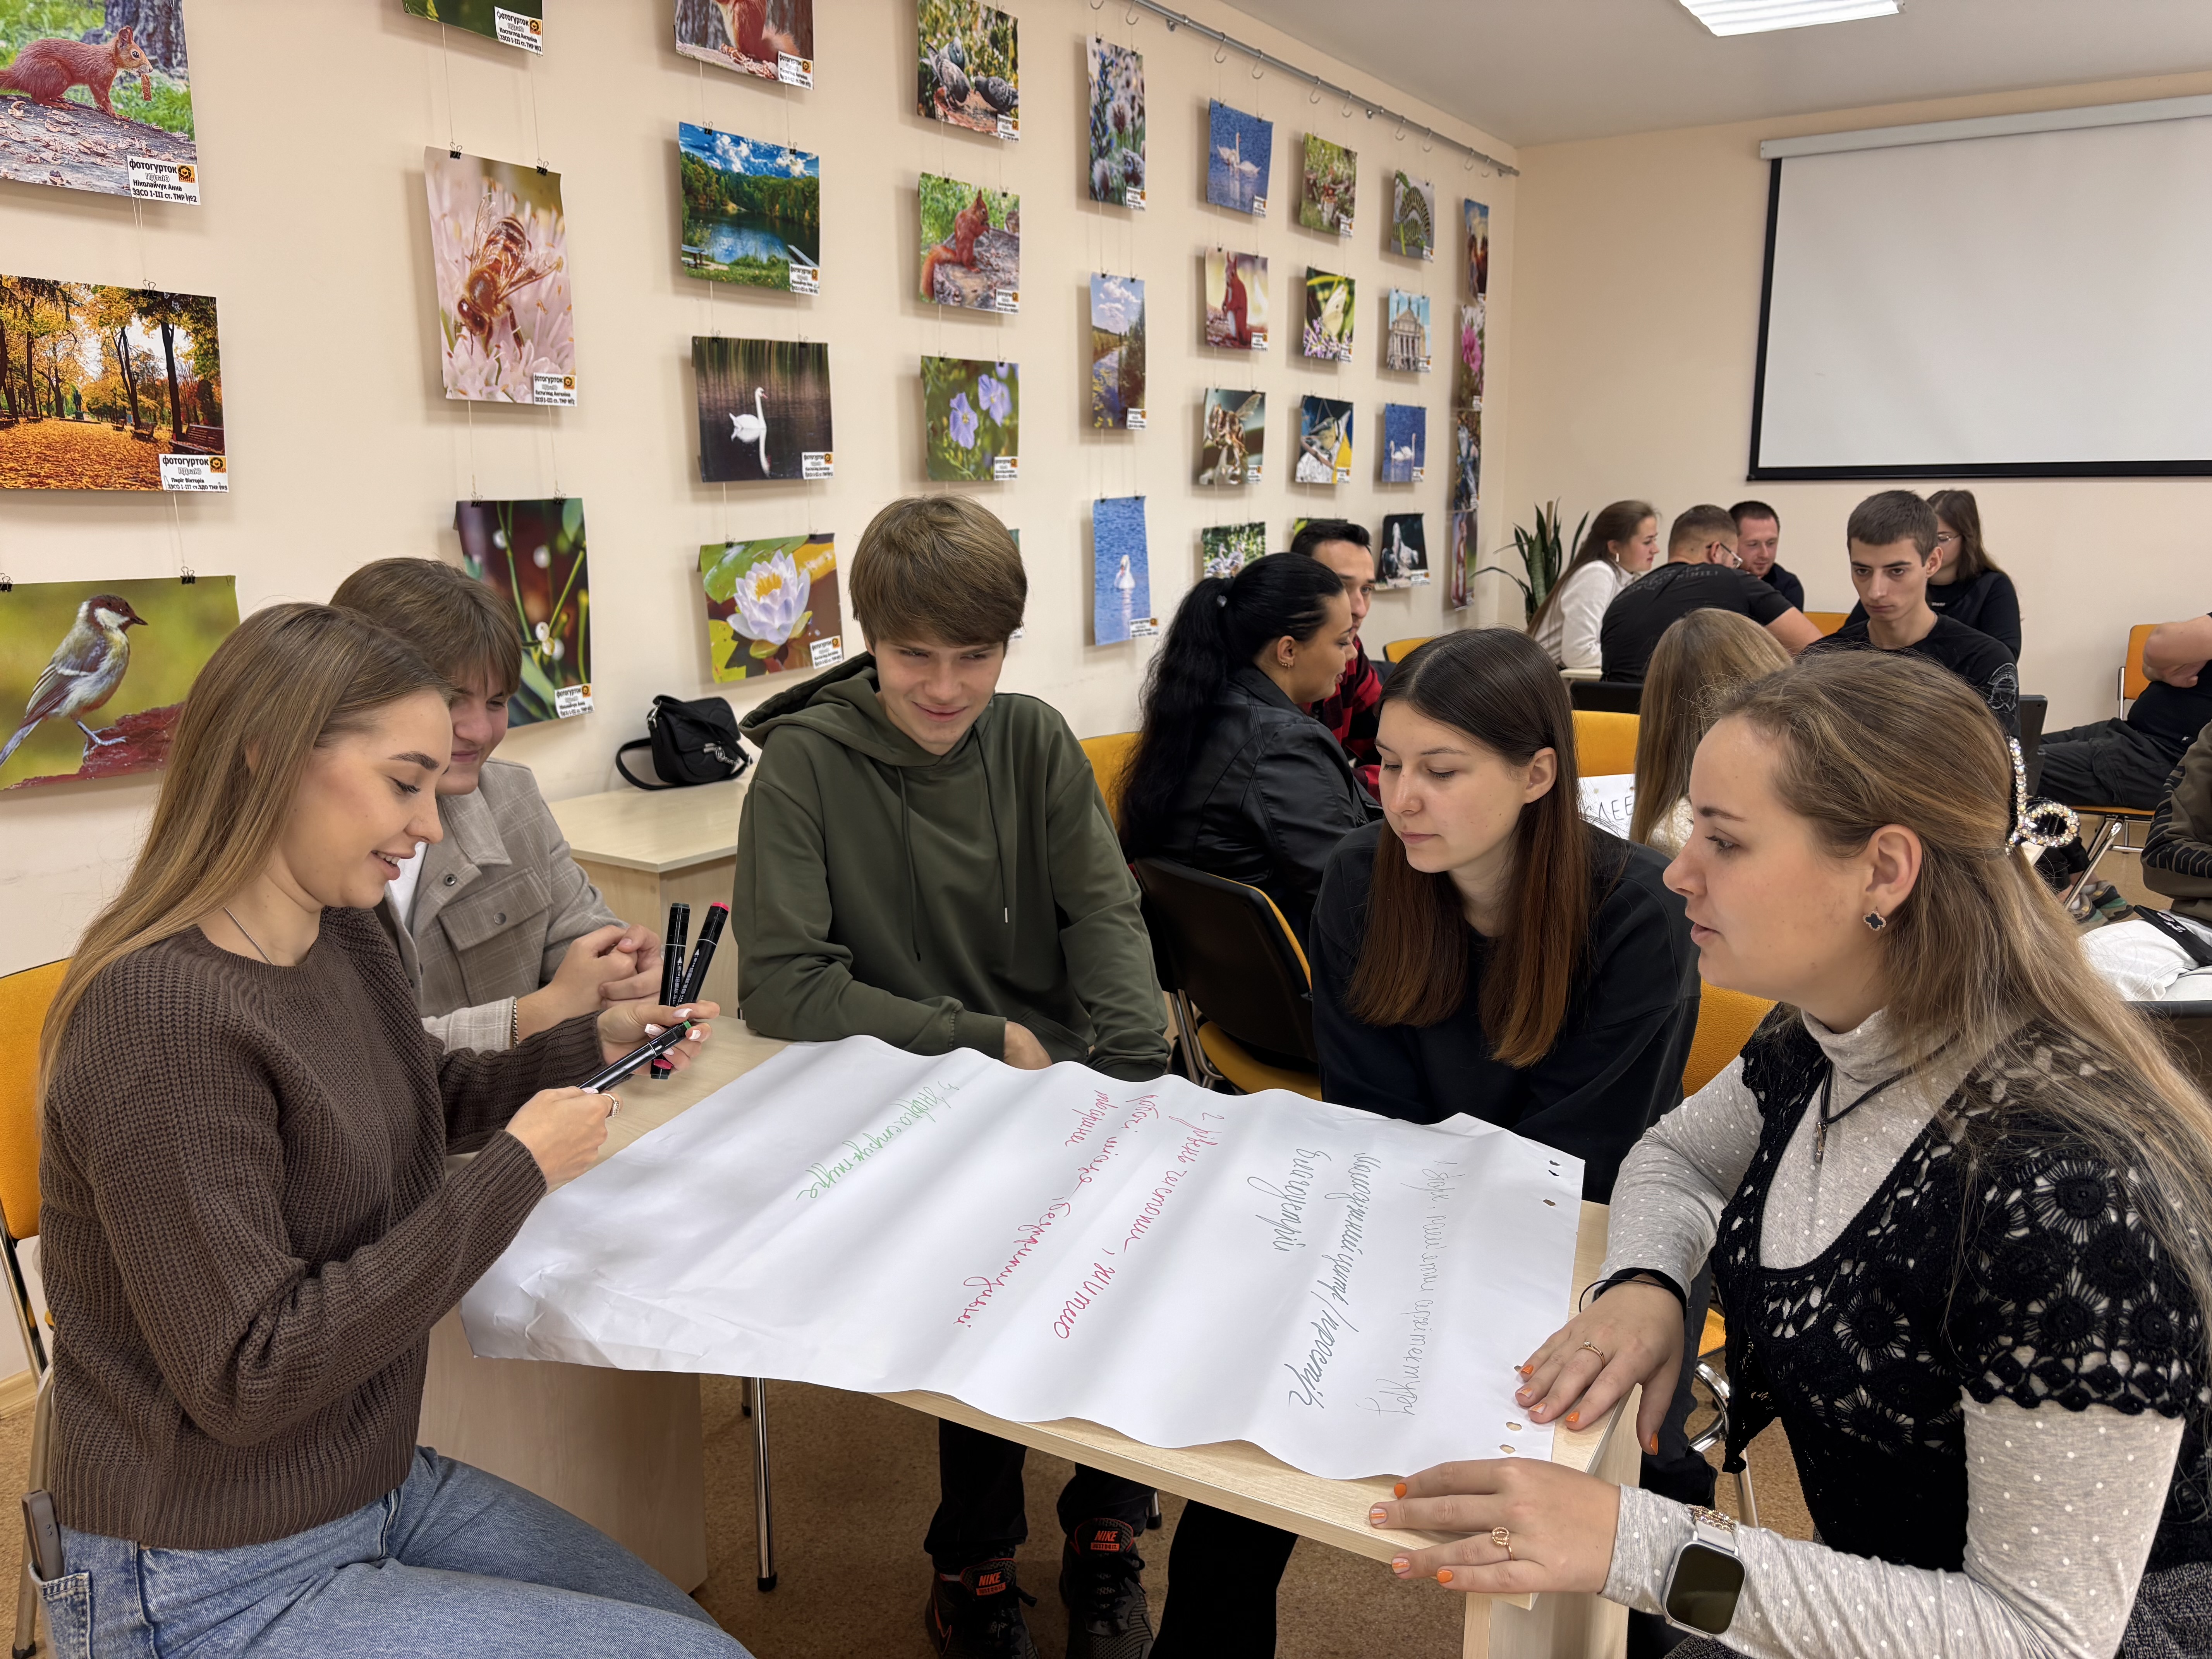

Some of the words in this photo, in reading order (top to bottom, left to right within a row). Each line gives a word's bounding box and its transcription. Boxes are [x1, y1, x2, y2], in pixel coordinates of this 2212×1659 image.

[129, 158, 177, 173] фотогурток
[133, 179, 167, 190] Ніколайчук
[163, 455, 209, 467] фотогурток
[1065, 1090, 1119, 1147] тварини
[1247, 1149, 1332, 1252] Благоустрій
[1324, 1152, 1381, 1255] Молодіжний
[1053, 1262, 1116, 1339] житло
[1094, 1530, 1118, 1542] NIKE
[979, 1571, 1001, 1586] NIKE
